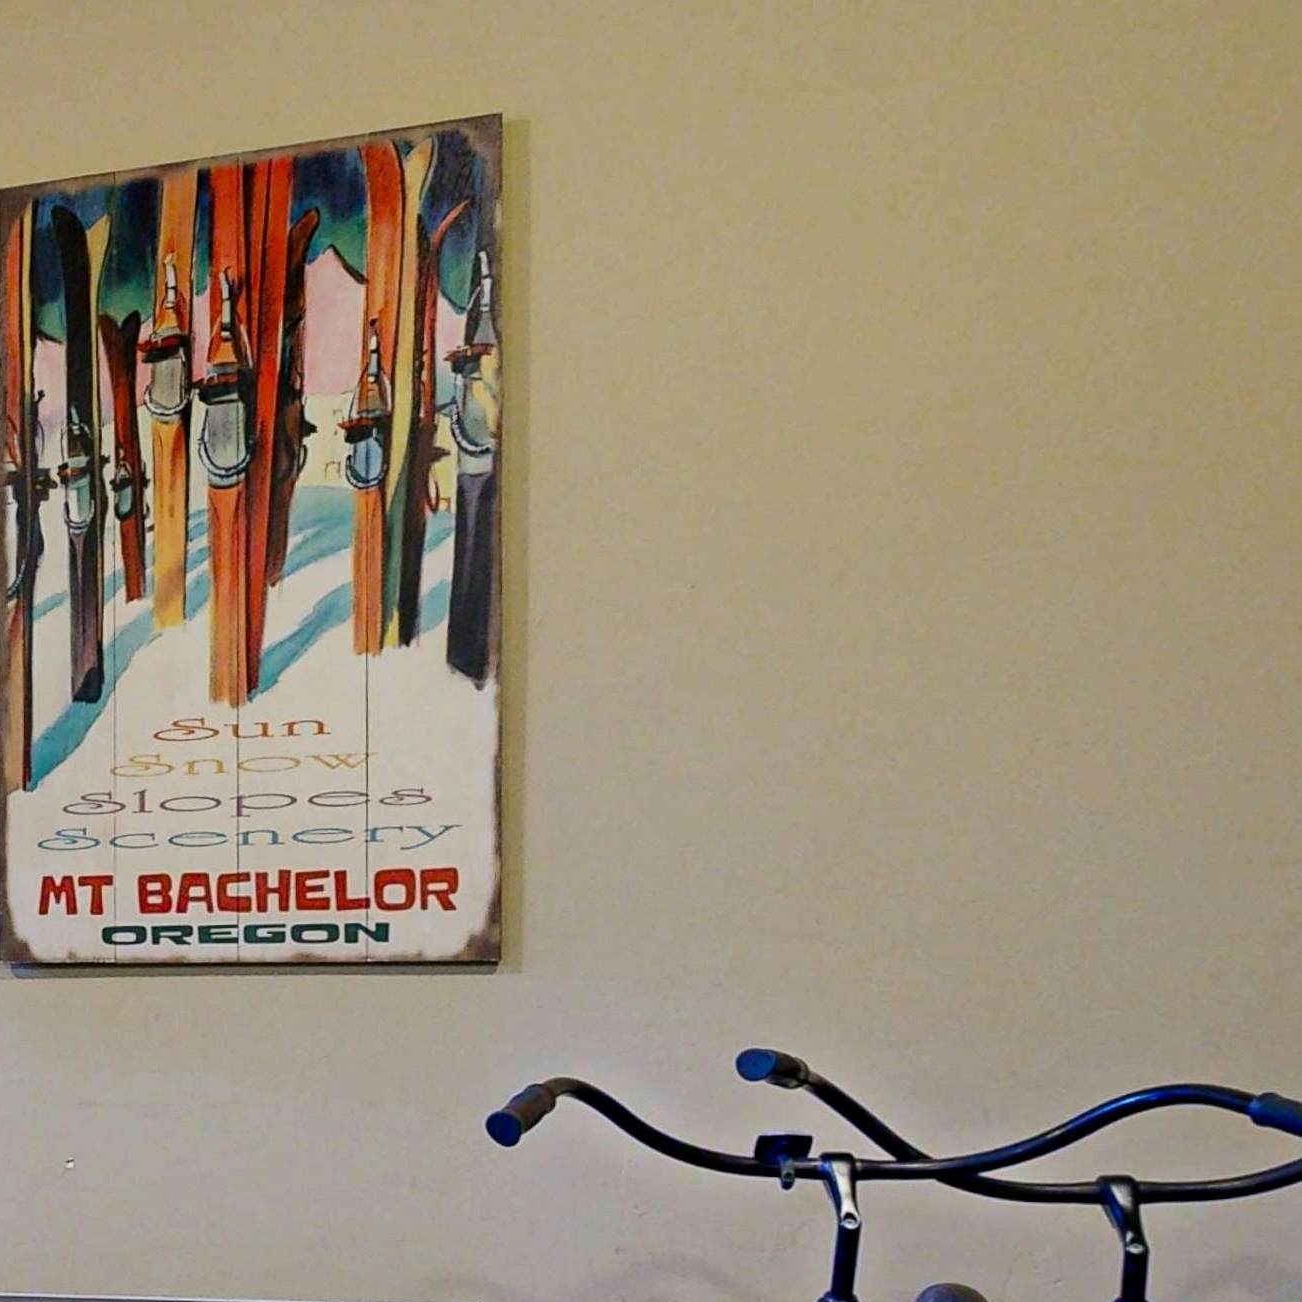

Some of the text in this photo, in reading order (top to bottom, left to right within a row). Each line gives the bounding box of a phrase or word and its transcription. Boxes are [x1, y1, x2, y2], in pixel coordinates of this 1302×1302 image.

[153, 716, 332, 742] Sun
[110, 751, 379, 778] Snow
[62, 788, 434, 818] Slopes
[37, 824, 463, 851] Scenery
[38, 867, 459, 915] MT BACHELOR
[101, 922, 390, 945] OREGON
